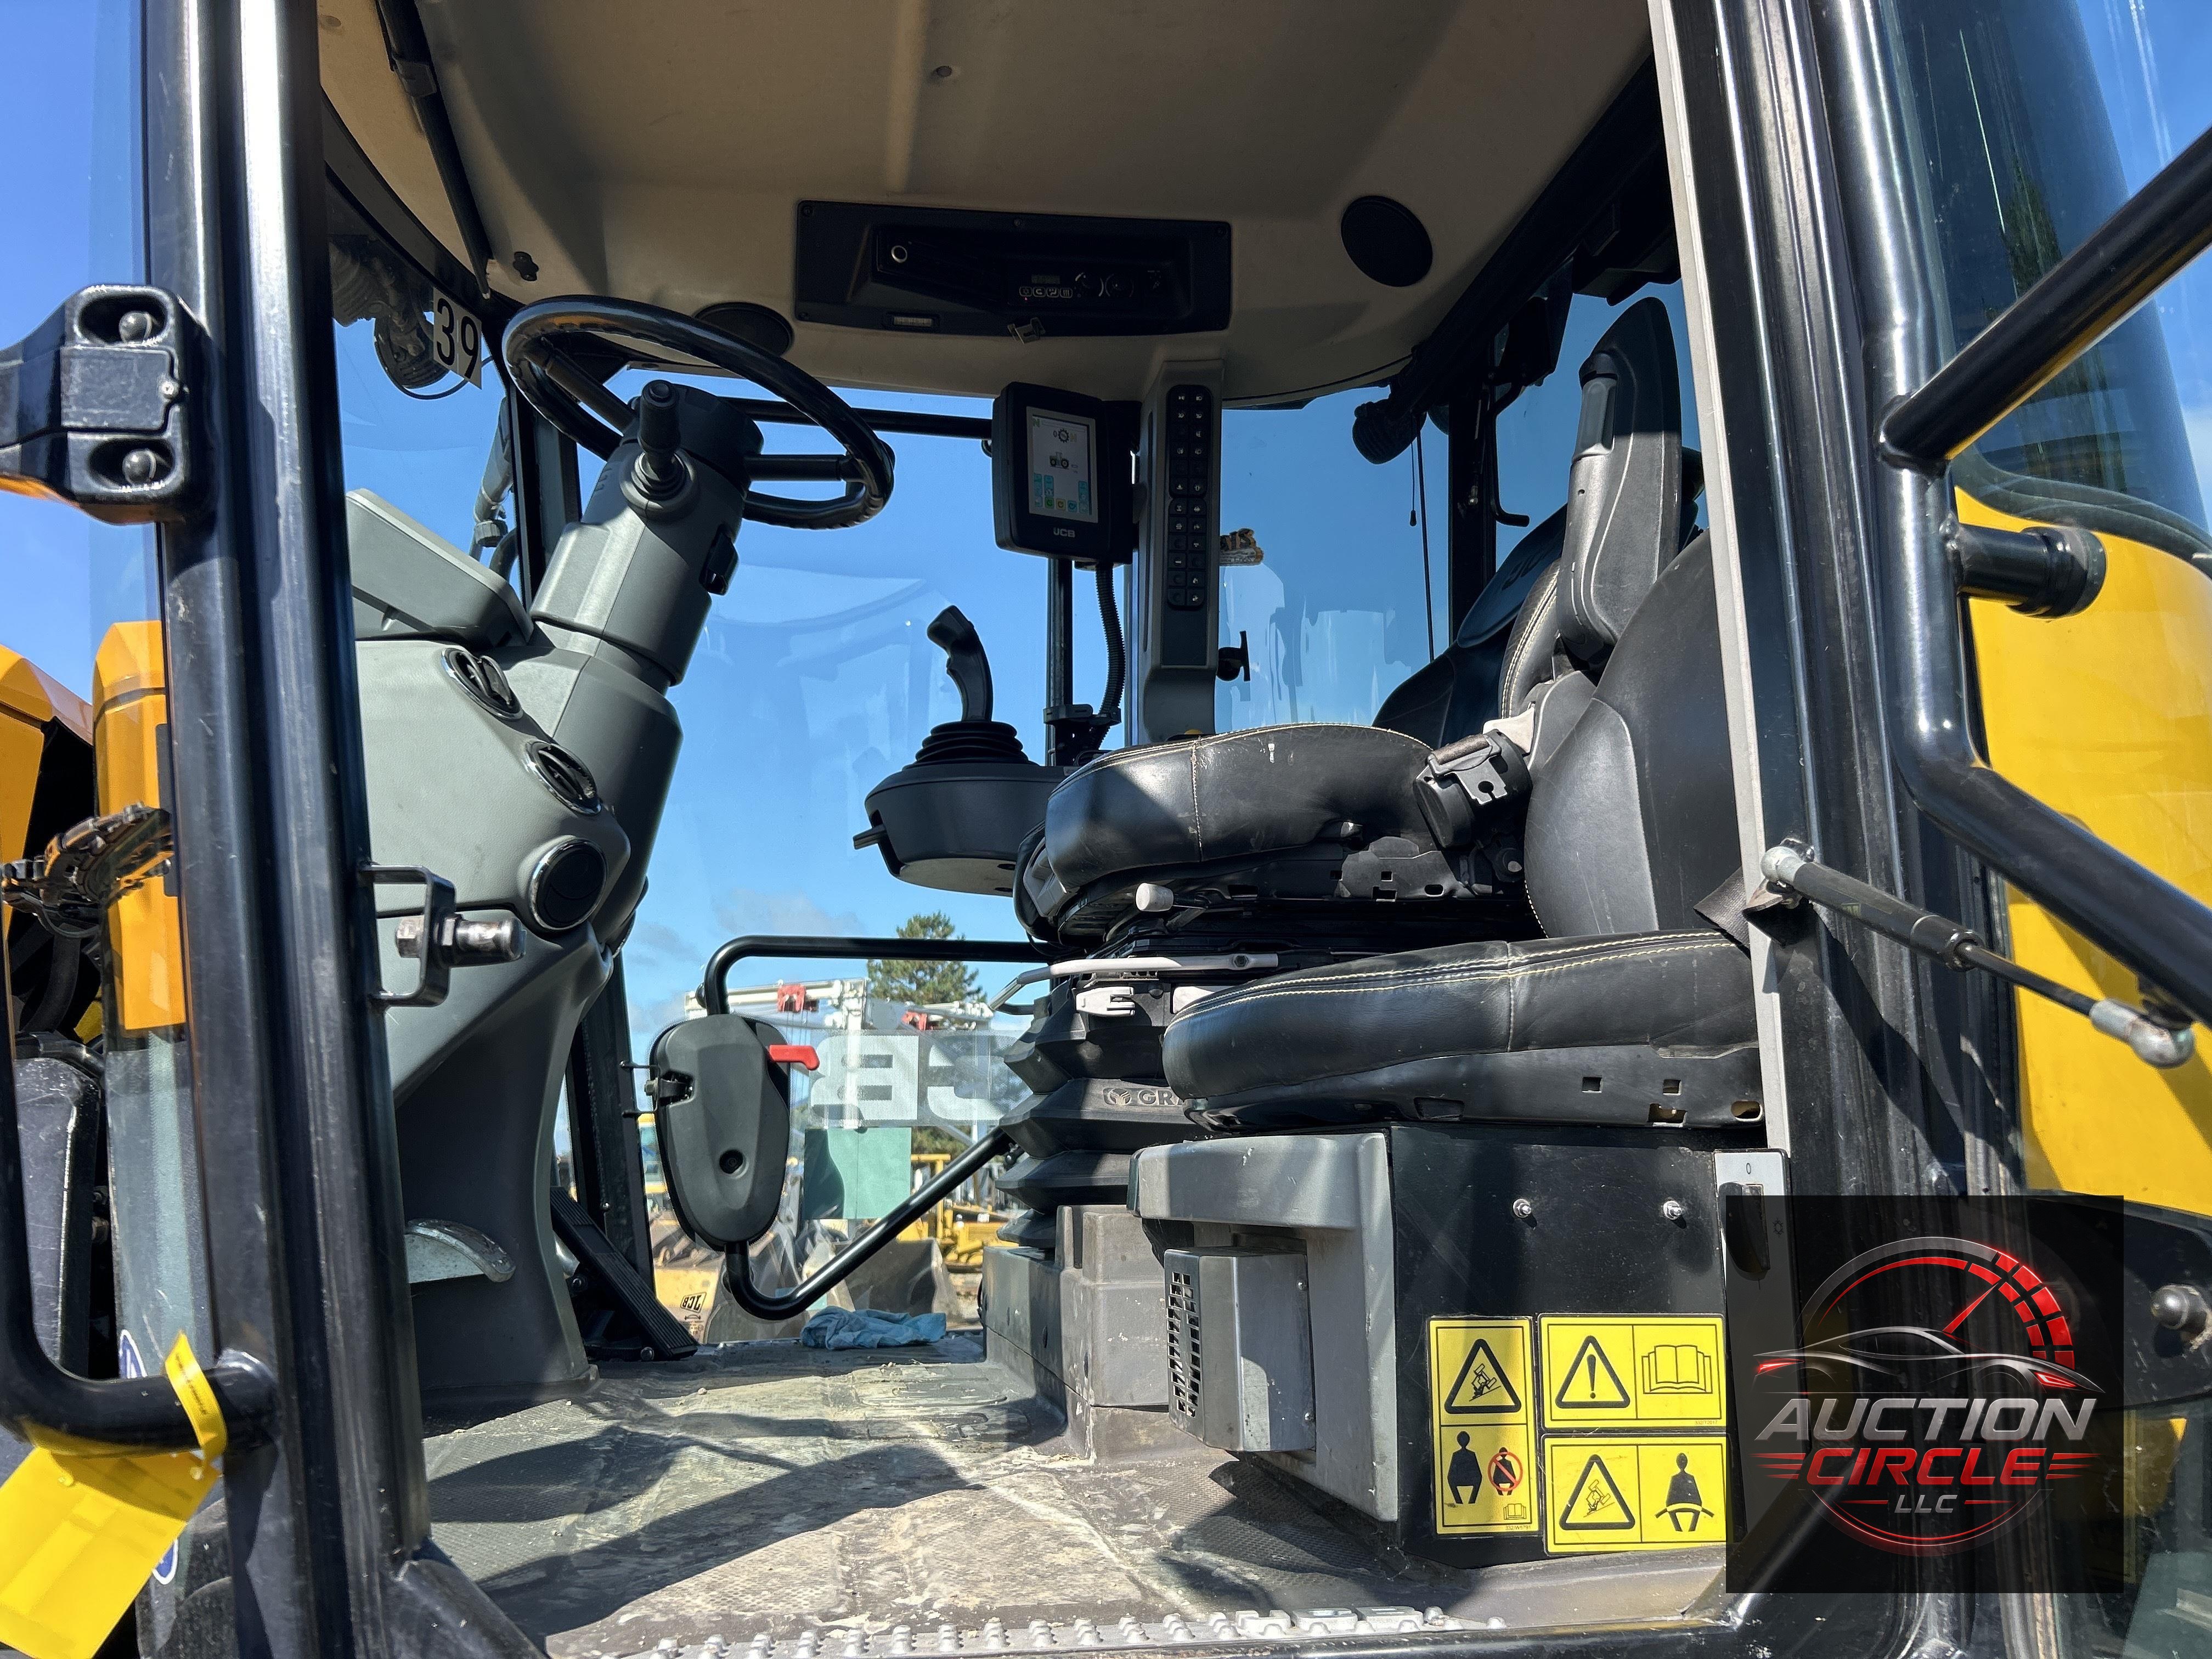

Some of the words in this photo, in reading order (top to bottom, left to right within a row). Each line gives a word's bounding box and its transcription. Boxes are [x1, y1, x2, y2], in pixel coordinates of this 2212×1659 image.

[437, 298, 478, 379] 39
[1053, 527, 1075, 538] JCB
[1138, 1089, 1183, 1105] GR
